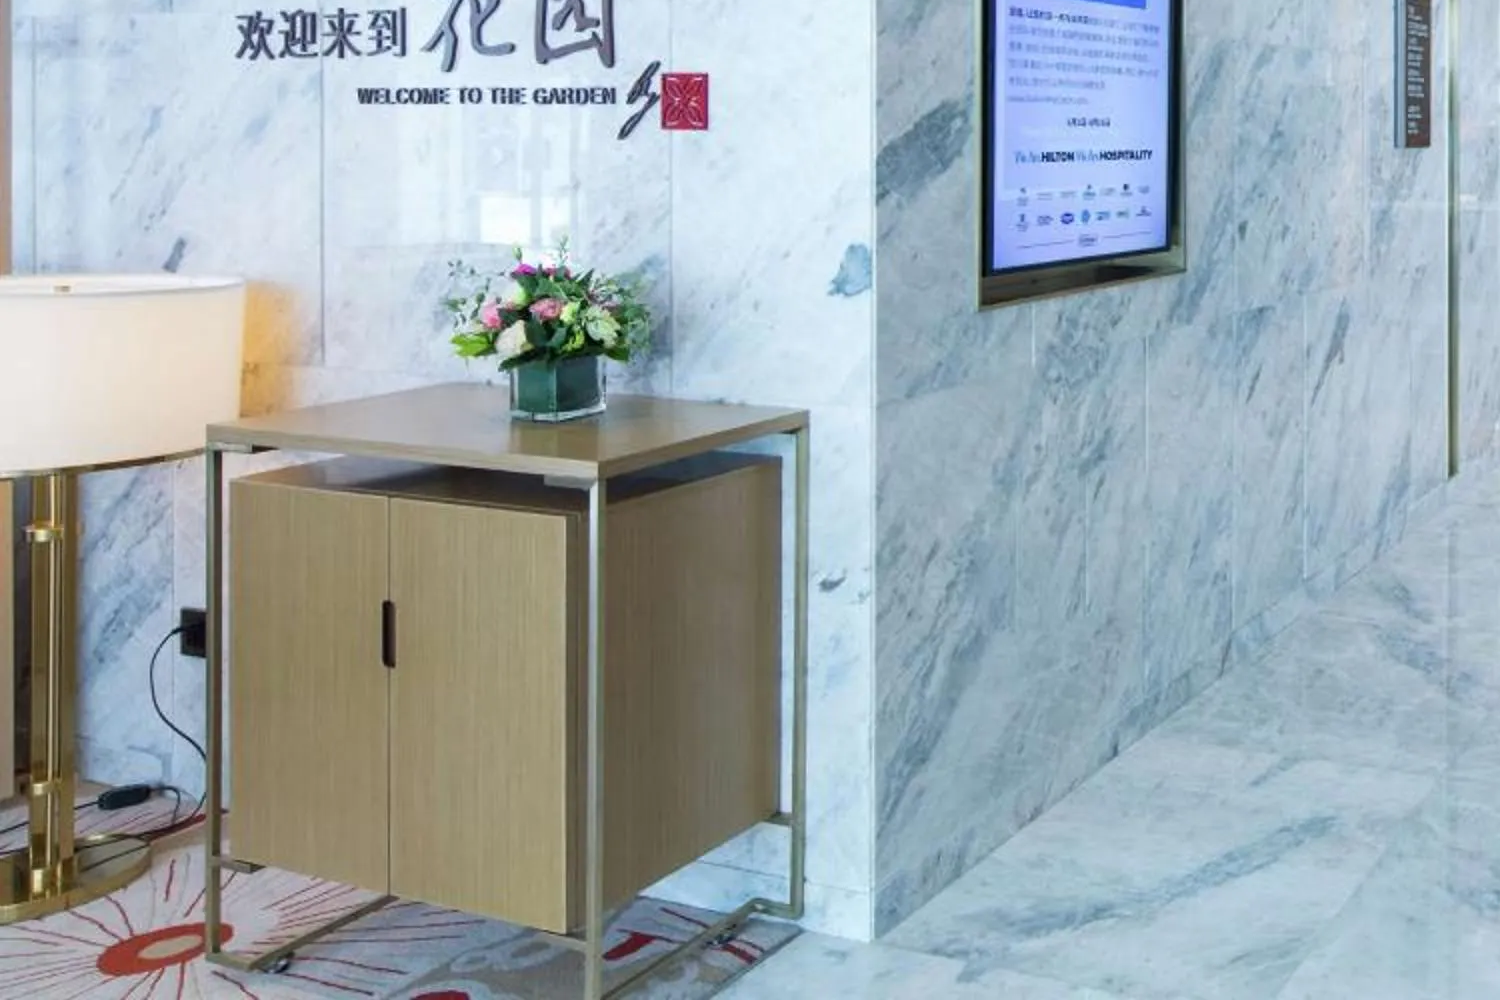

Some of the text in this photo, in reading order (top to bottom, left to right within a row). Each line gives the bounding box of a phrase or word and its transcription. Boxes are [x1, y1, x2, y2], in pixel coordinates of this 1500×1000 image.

[235, 6, 408, 60] 欢迎来到
[357, 87, 617, 105] WELCOME TO THE GARDEN
[1041, 151, 1075, 163] HILTON
[1099, 149, 1153, 161] HOSPITALITY
